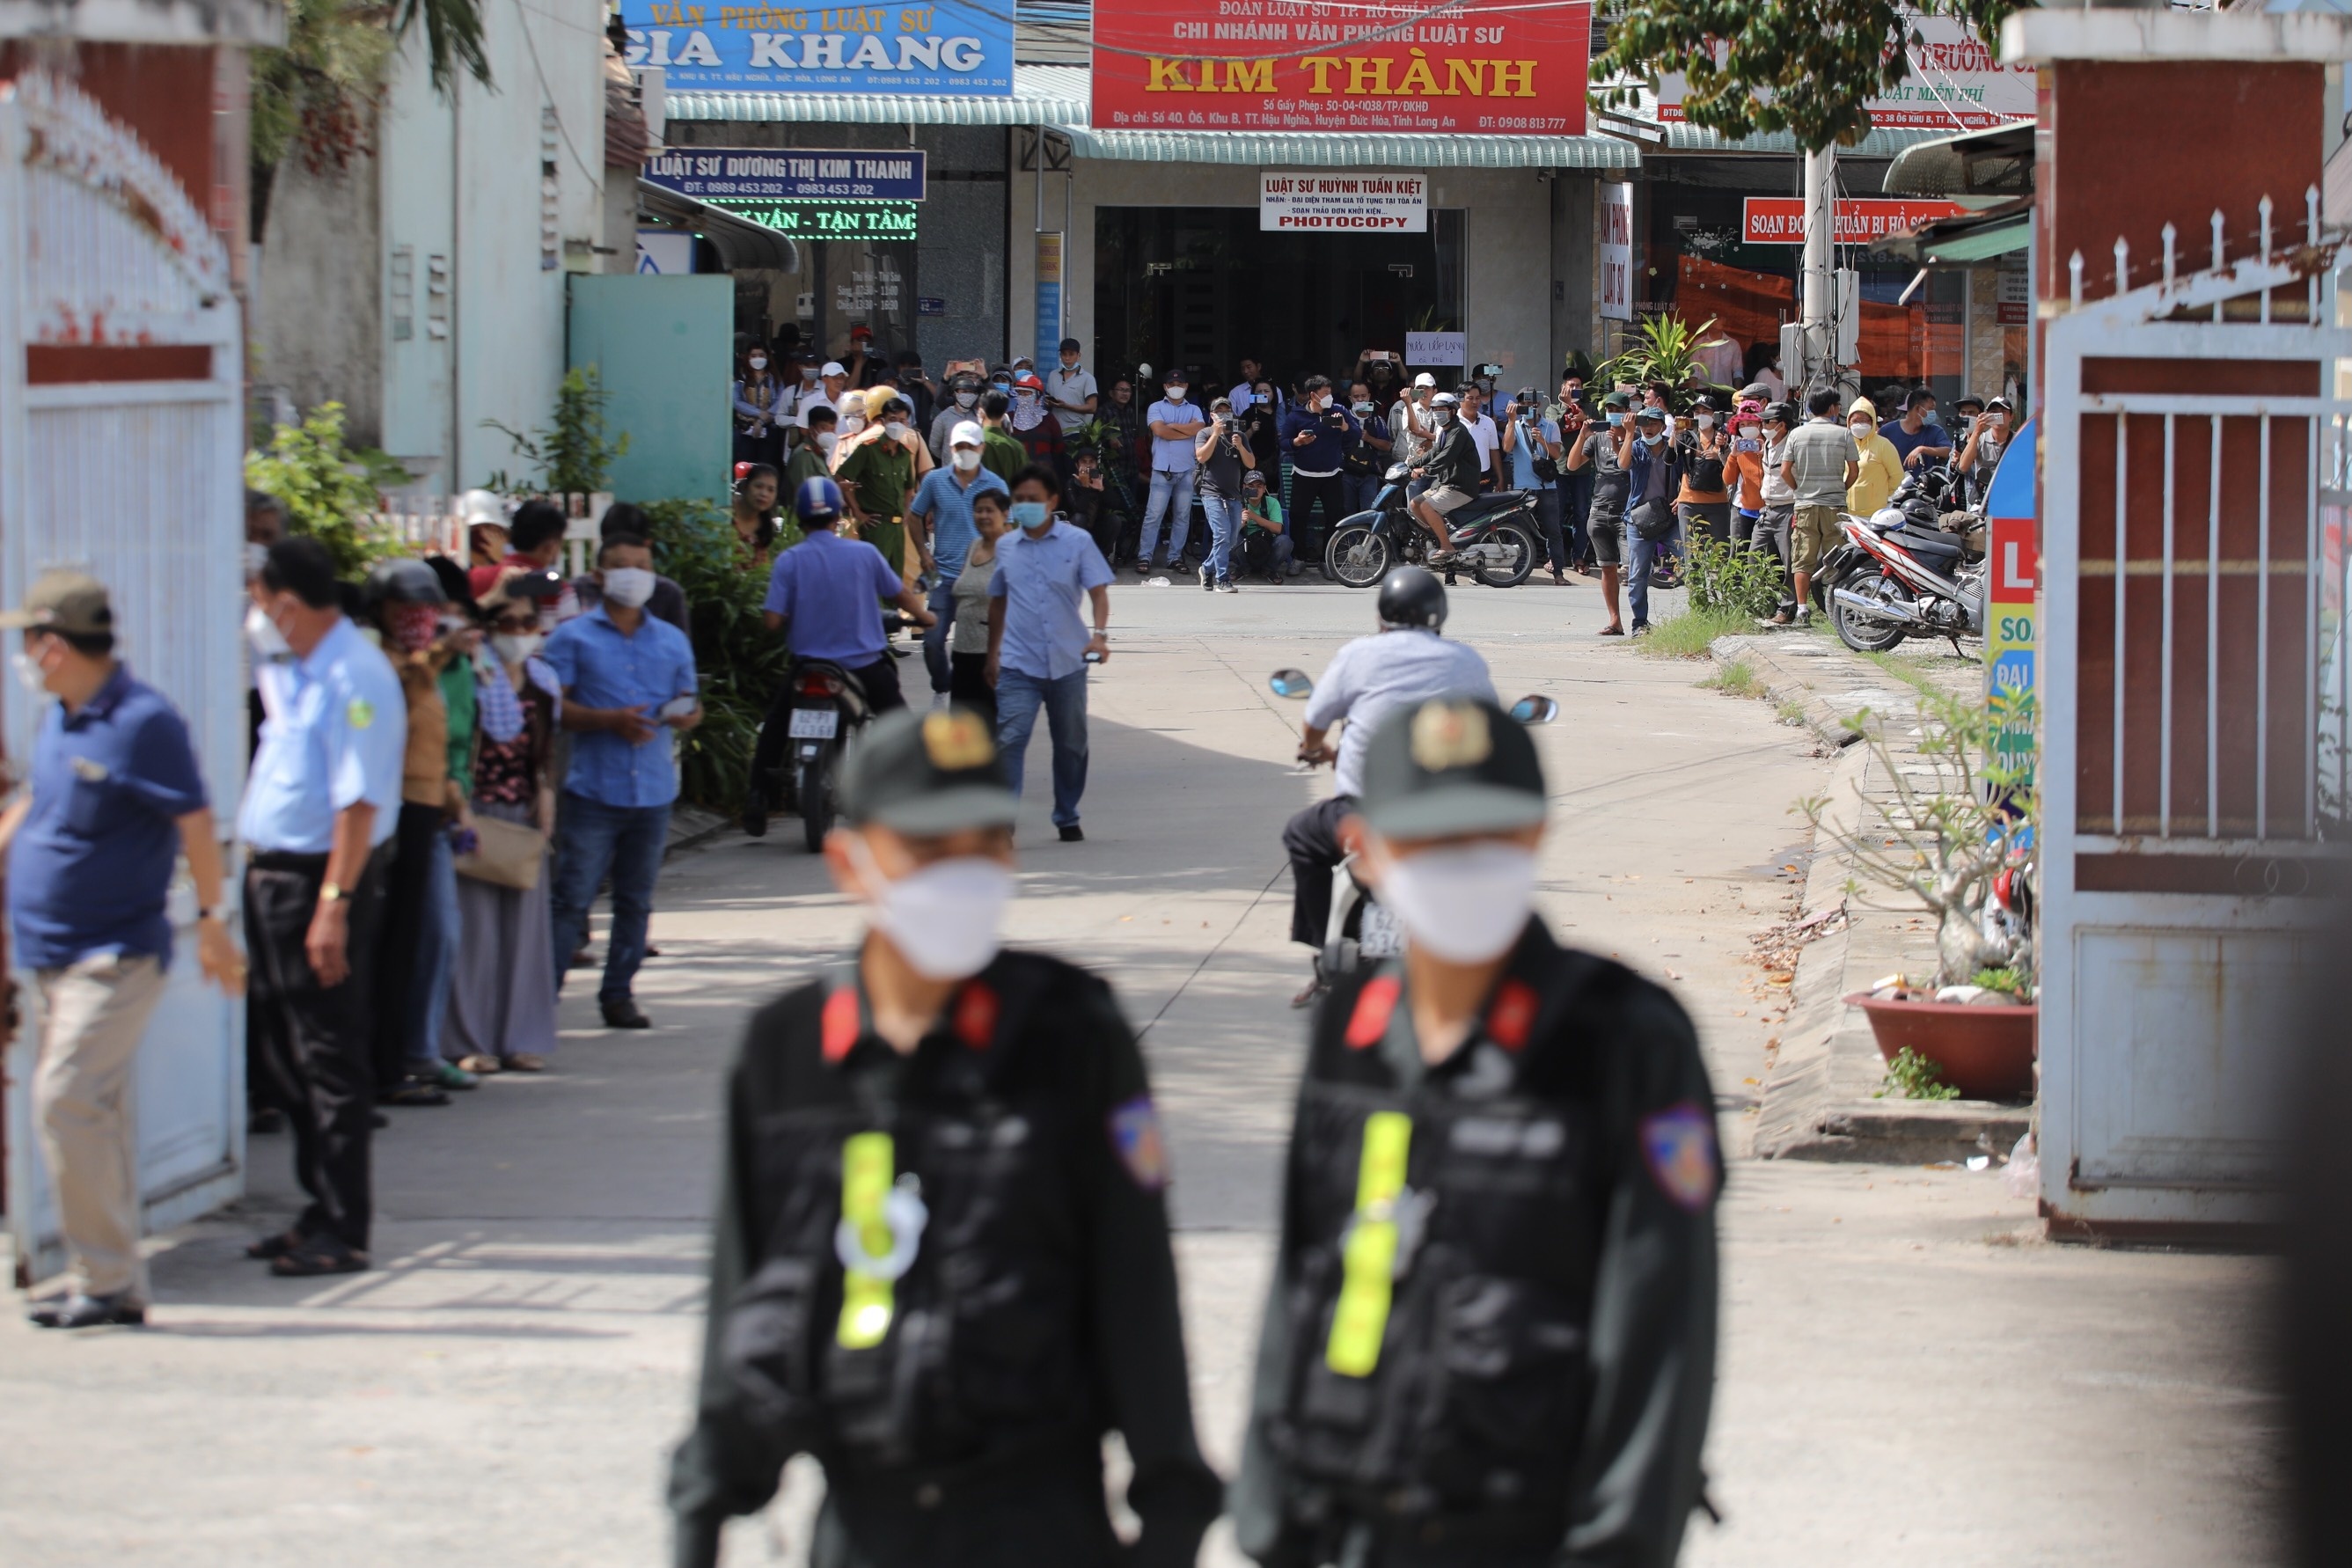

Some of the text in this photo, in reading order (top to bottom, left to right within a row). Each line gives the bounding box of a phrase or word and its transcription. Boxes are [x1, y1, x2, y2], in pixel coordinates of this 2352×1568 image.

[649, 1, 936, 36] VĂN PHÒNG LUẬT SƯ
[1220, 0, 1262, 16] ĐOÀN
[1267, 1, 1306, 19] LUẬT
[1337, 4, 1359, 18] TP.
[1173, 19, 1505, 47] CHI NHÁNH VĂN PHÒNG LUẬT SƯ
[625, 30, 985, 72] GIA KHANG
[924, 77, 941, 86] 202
[1145, 47, 1538, 97] KIM THÀNH
[1264, 98, 1275, 111] Số
[1113, 111, 1129, 126] Địa
[1153, 110, 1165, 124] Số
[1168, 112, 1184, 125] 40,
[1209, 113, 1227, 124] Khu
[1232, 113, 1241, 126] B,
[1245, 113, 1259, 125] TT.
[1262, 113, 1279, 128] Hậu
[1315, 114, 1345, 129] Huyện
[1349, 114, 1368, 126] Đức
[1372, 114, 1391, 128] Hòa,
[1416, 115, 1438, 130] Long
[1442, 116, 1455, 128] An
[1478, 116, 1496, 128] ĐT:
[1498, 117, 1527, 129] 0908
[1528, 118, 1545, 129] 813
[1547, 118, 1566, 130] 777
[651, 153, 912, 182] LUẬT SƯ DƯƠNG THỊ KIM THANH
[684, 181, 874, 195] ĐT: 0989 453 202 0983 453 202
[1265, 176, 1422, 197] LUẬT SƯ HUỲNH TUẤN KIỆT
[1292, 196, 1303, 205] ĐẠI
[1367, 197, 1383, 206] TỤNG
[1385, 197, 1396, 206] TẠI
[817, 210, 861, 233] TẬN
[865, 209, 913, 230] TÂM
[1279, 216, 1408, 228] PHOTOCOPY
[1751, 215, 1784, 238] SOẠN
[1834, 204, 1869, 234] HUẨN
[1888, 205, 1907, 232] HỒ
